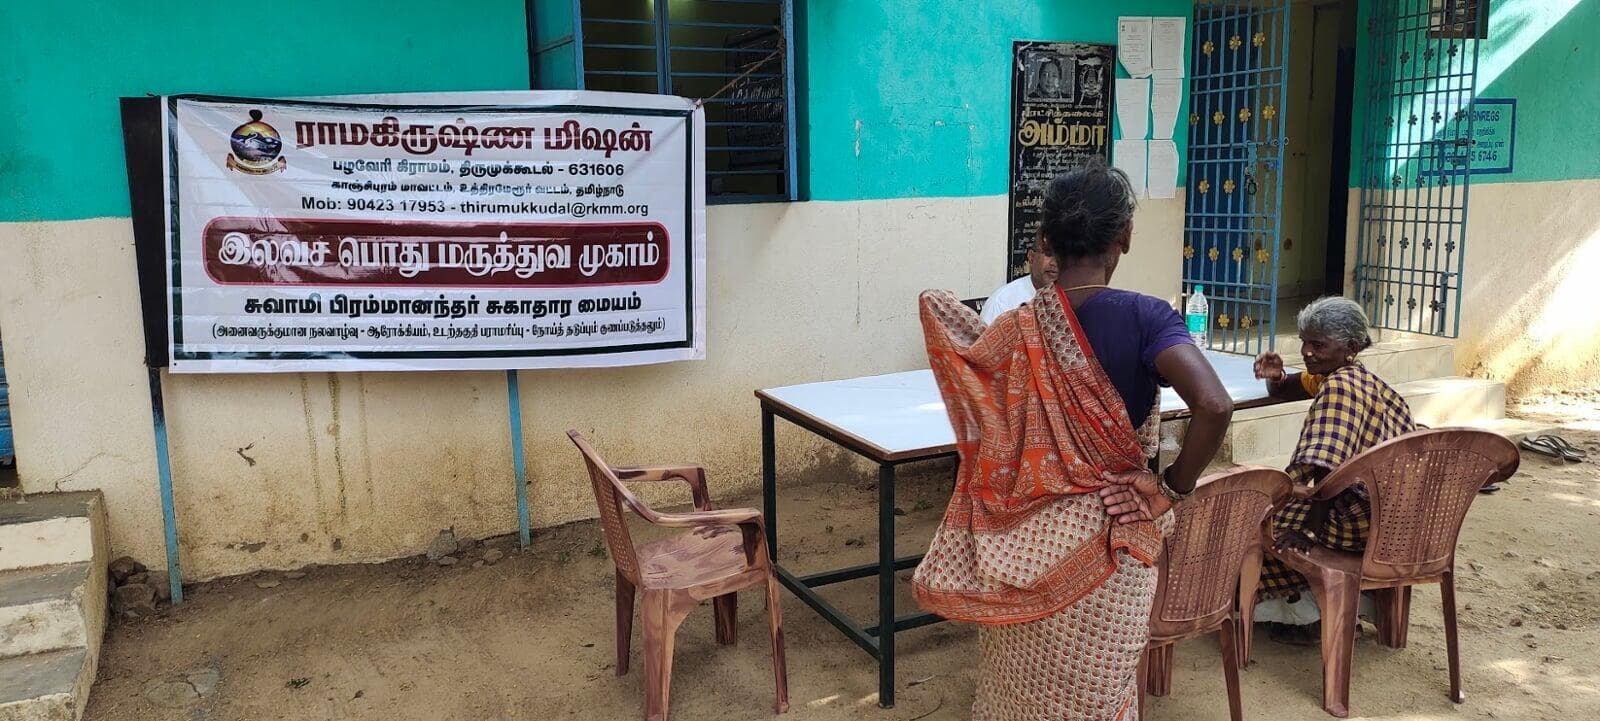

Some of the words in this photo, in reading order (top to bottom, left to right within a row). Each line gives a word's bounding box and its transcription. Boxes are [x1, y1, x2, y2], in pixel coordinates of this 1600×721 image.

[295, 116, 534, 156] ராமகிருஷ்ண
[544, 119, 653, 158] மிஷன்
[333, 158, 392, 175] பழவேரி
[396, 159, 454, 175] கிராமம்,
[459, 161, 553, 177] திருமுக்கூடல்
[568, 163, 625, 176] 631606
[331, 180, 397, 193] காஞ்சிபுரம்
[400, 182, 456, 193] மாவட்டம்,
[459, 183, 532, 196] உத்திரமேரூர்
[535, 184, 572, 196] வட்டம்,
[575, 184, 624, 197] தமிழ்நாடு
[301, 196, 341, 211] Mob:
[347, 198, 394, 211] 90423
[400, 200, 445, 213] 17953
[460, 201, 649, 217] thirumukkudal@rkmm.org
[218, 231, 331, 266] இலவச
[338, 237, 429, 278] பொது
[438, 231, 571, 279] மருத்துவ
[578, 230, 660, 277] முகாம்
[244, 294, 322, 315] சுவாமி
[329, 293, 480, 319] பிரம்மானந்தர்
[486, 298, 572, 319] சுகாதார
[577, 291, 642, 314] மையம்
[212, 322, 307, 340] (அனைவருக்குமான
[309, 324, 359, 342] நலவாழ்வு
[366, 323, 431, 340] ஆரோக்கியம்,
[480, 322, 524, 339] பராமரிப்பு
[531, 321, 565, 338] நோய்த்
[565, 320, 598, 337] தடுப்பும்
[599, 316, 666, 336] குணப்படுத்தலும்)
